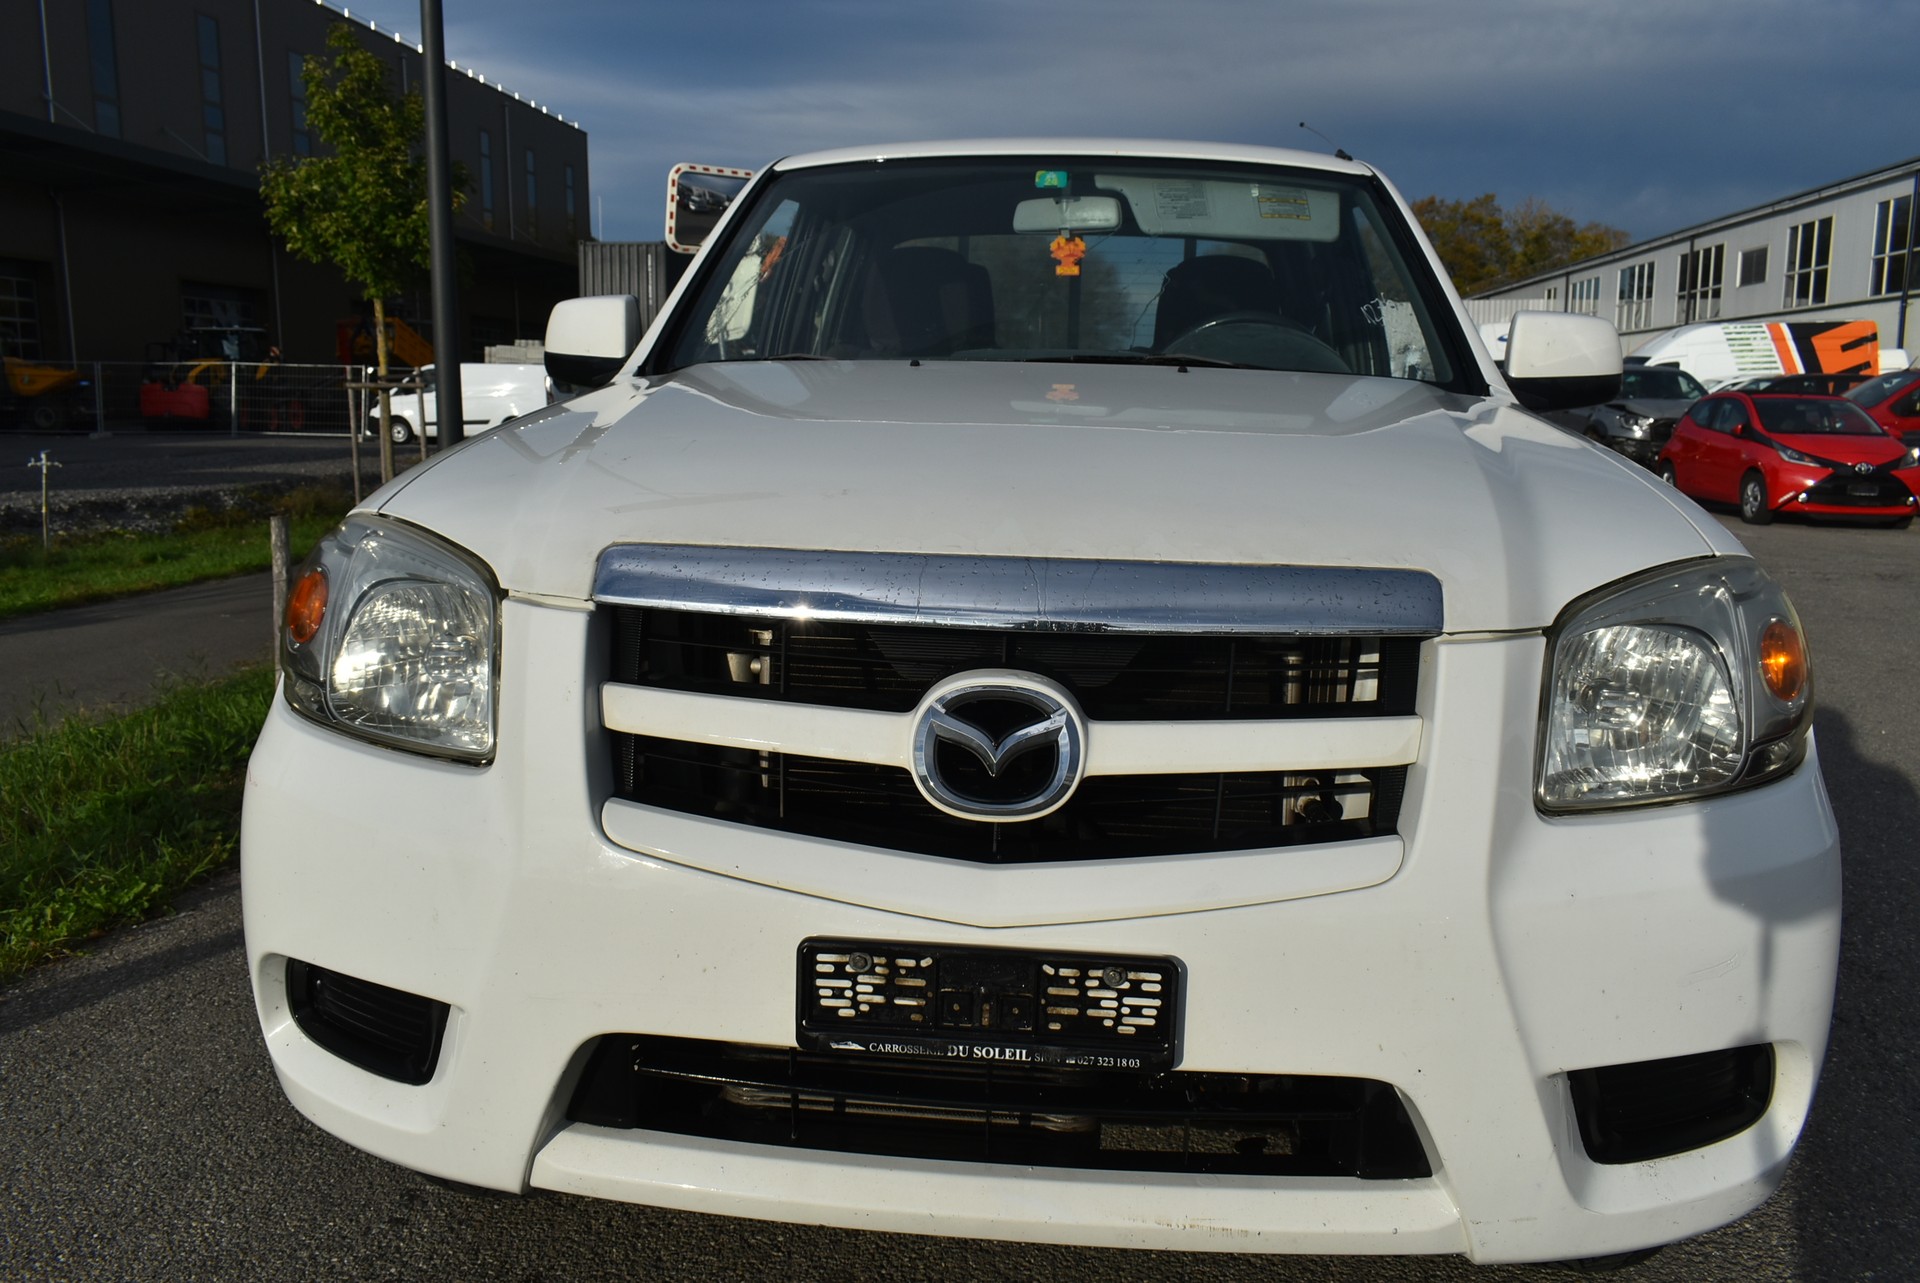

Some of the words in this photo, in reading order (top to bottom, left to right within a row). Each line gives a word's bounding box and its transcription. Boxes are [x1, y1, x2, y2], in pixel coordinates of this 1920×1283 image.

[946, 1044, 969, 1057] DU
[973, 1046, 1032, 1061] SOLEIL
[1077, 1055, 1095, 1065] 027
[1097, 1056, 1114, 1067] 323
